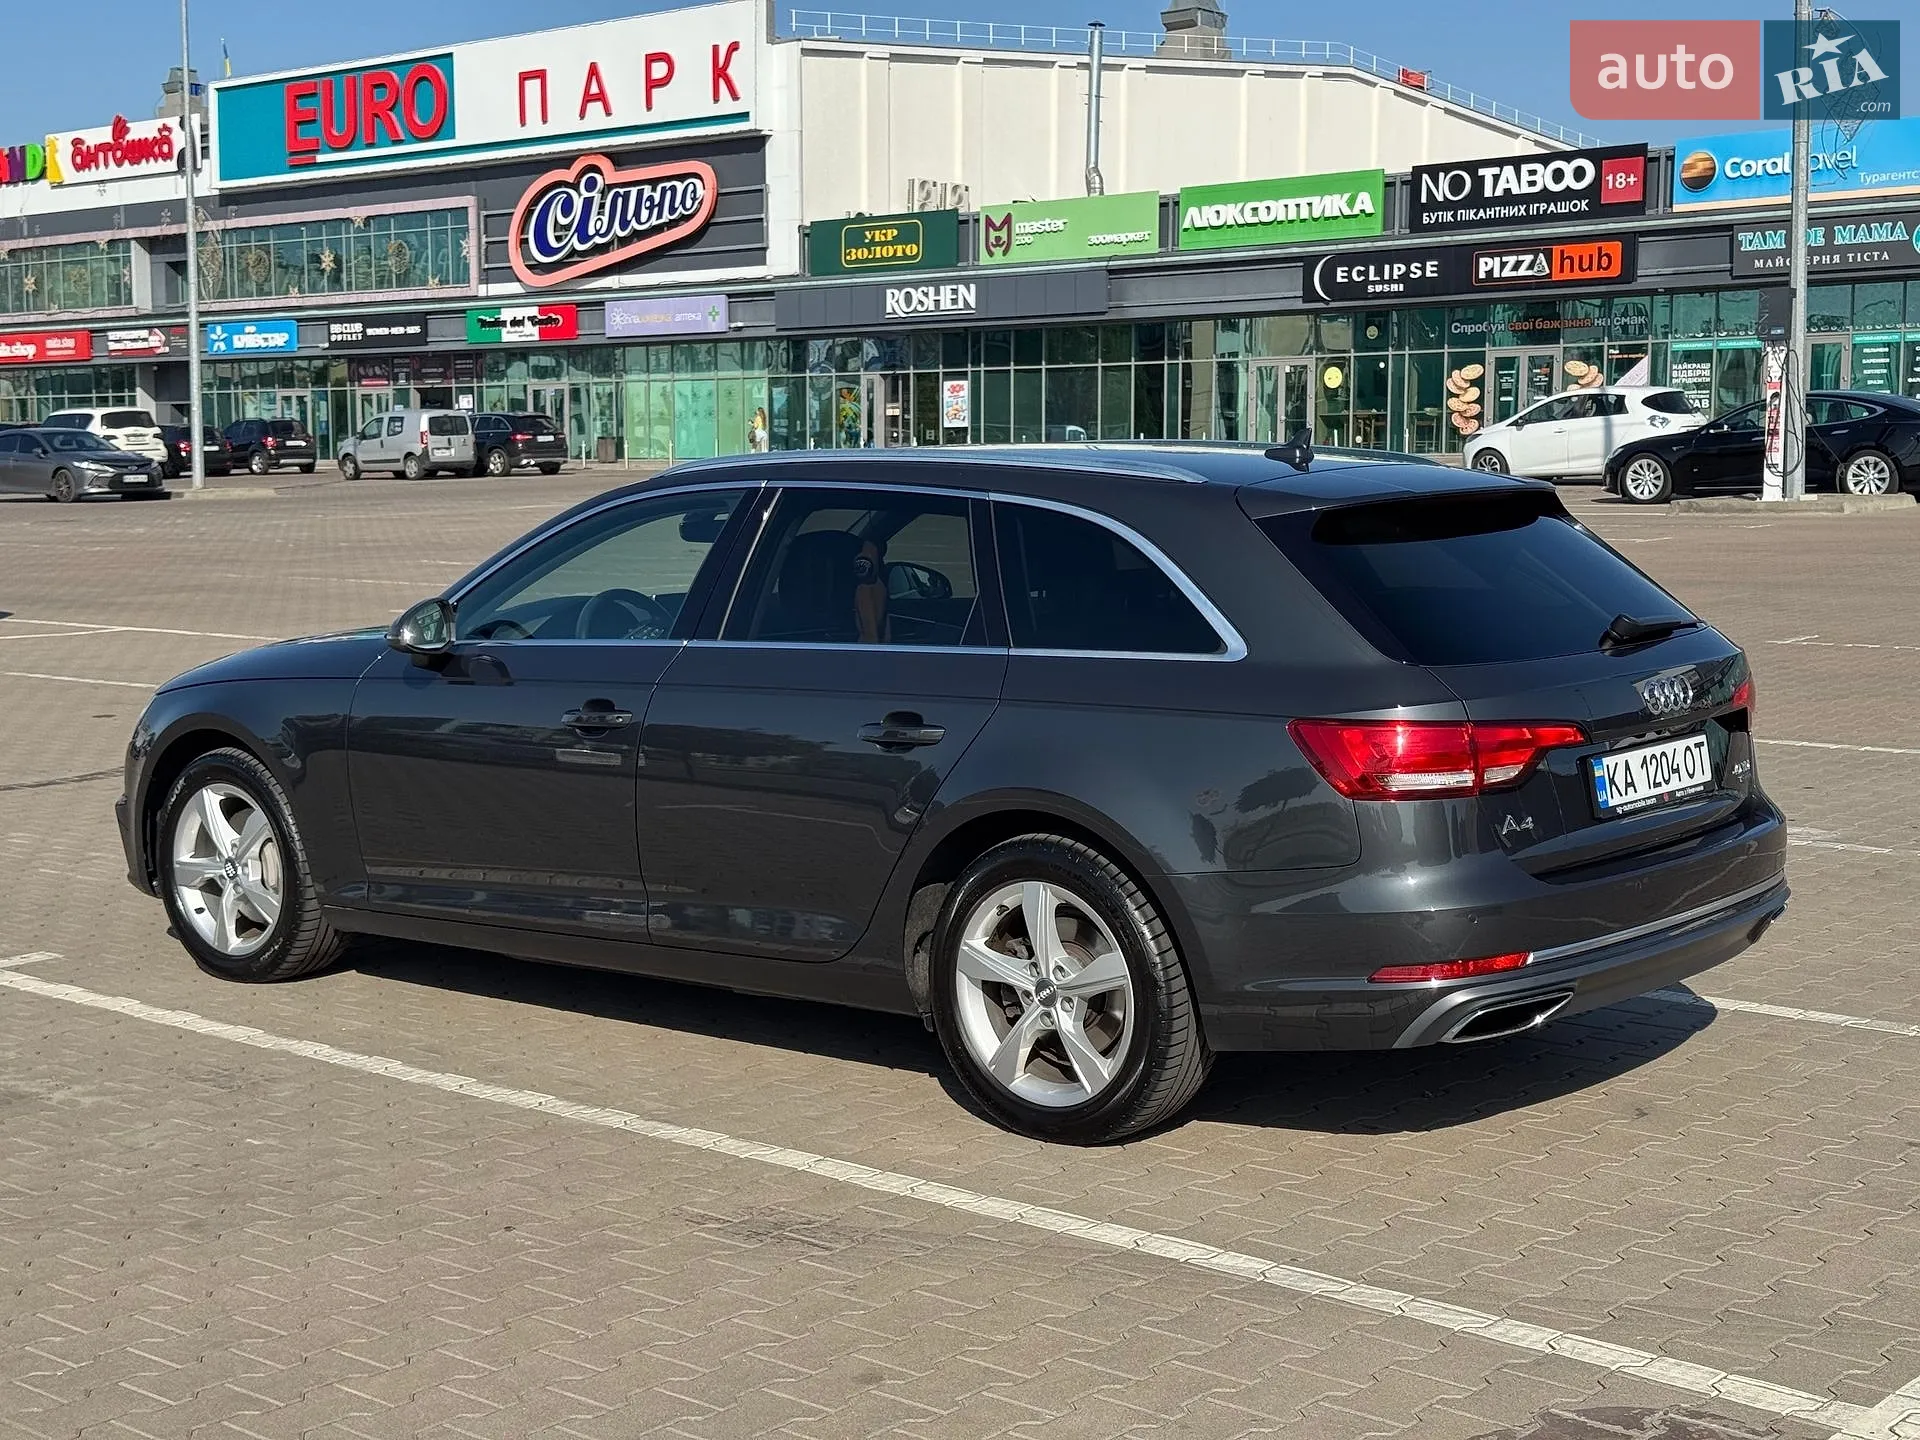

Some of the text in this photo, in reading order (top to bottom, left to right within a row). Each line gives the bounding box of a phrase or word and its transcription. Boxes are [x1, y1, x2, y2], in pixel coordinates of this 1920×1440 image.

[285, 40, 741, 155] EURO ПАРК
[1724, 151, 1792, 179] Coral
[1420, 157, 1597, 203] NO TABOO
[1604, 173, 1638, 191] 18+
[1858, 170, 1920, 186] Турагентс
[529, 172, 704, 263] Сільпо
[1182, 191, 1376, 231] ЛЮКСОПТИКА
[1421, 199, 1590, 226] БУТІК ПІКАНТНИХ ІГРАШОК
[863, 228, 899, 244] УКР
[1015, 218, 1068, 235] master
[1015, 235, 1034, 246] zoo
[1087, 231, 1152, 246] зоомаркет
[845, 243, 919, 261] ЗОЛОТО
[1477, 246, 1614, 279] PIZZA hub
[1846, 250, 1890, 263] ТІСТА
[1335, 260, 1440, 284] ECLIPSE
[1367, 283, 1405, 293] SUSHI
[885, 283, 977, 319] ROSHEN
[1451, 321, 1505, 336] Спробуй
[1508, 318, 1534, 332] свої
[1613, 314, 1648, 327] смак
[1672, 369, 1711, 378] ВІДБІРНІ
[1606, 759, 1638, 800] KA
[1640, 748, 1682, 790] 1204
[1683, 741, 1705, 780] OT
[1502, 814, 1535, 835] A4
